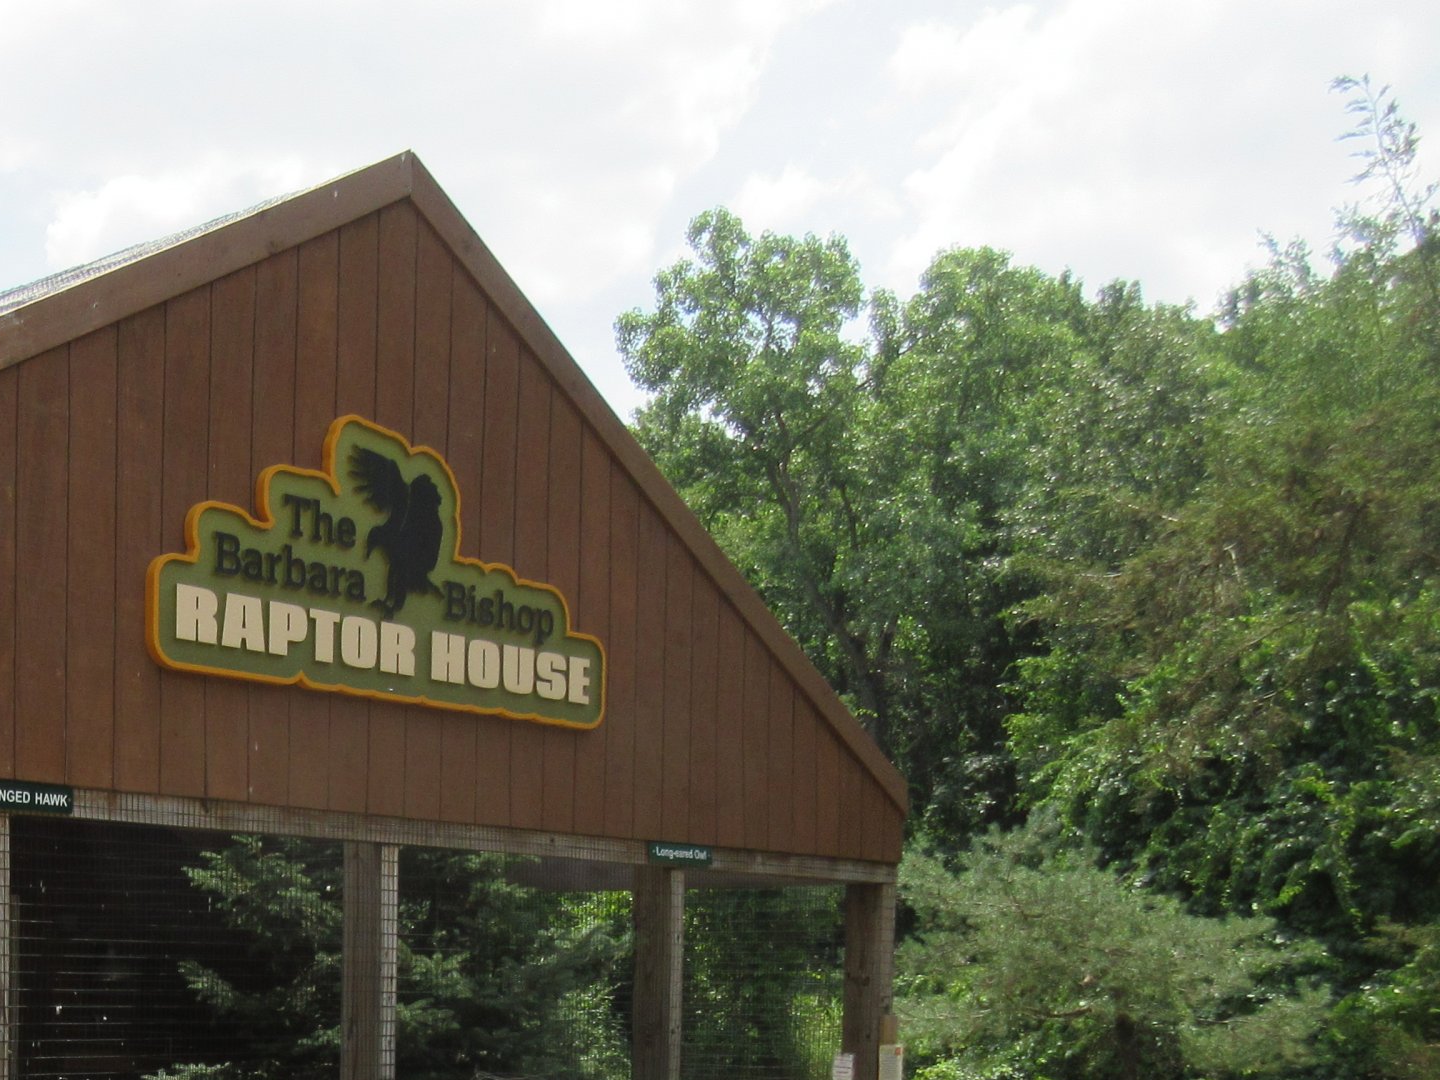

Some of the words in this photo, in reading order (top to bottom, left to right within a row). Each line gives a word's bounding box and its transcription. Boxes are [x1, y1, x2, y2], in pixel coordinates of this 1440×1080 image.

[282, 494, 357, 549] The
[214, 531, 367, 602] Barbara
[443, 580, 555, 645] Bishop
[175, 583, 416, 677] RAPTOR
[430, 630, 591, 705] HOUSE
[34, 792, 68, 807] HAWK
[655, 846, 693, 859] Long-eared
[694, 849, 707, 860] Owl
